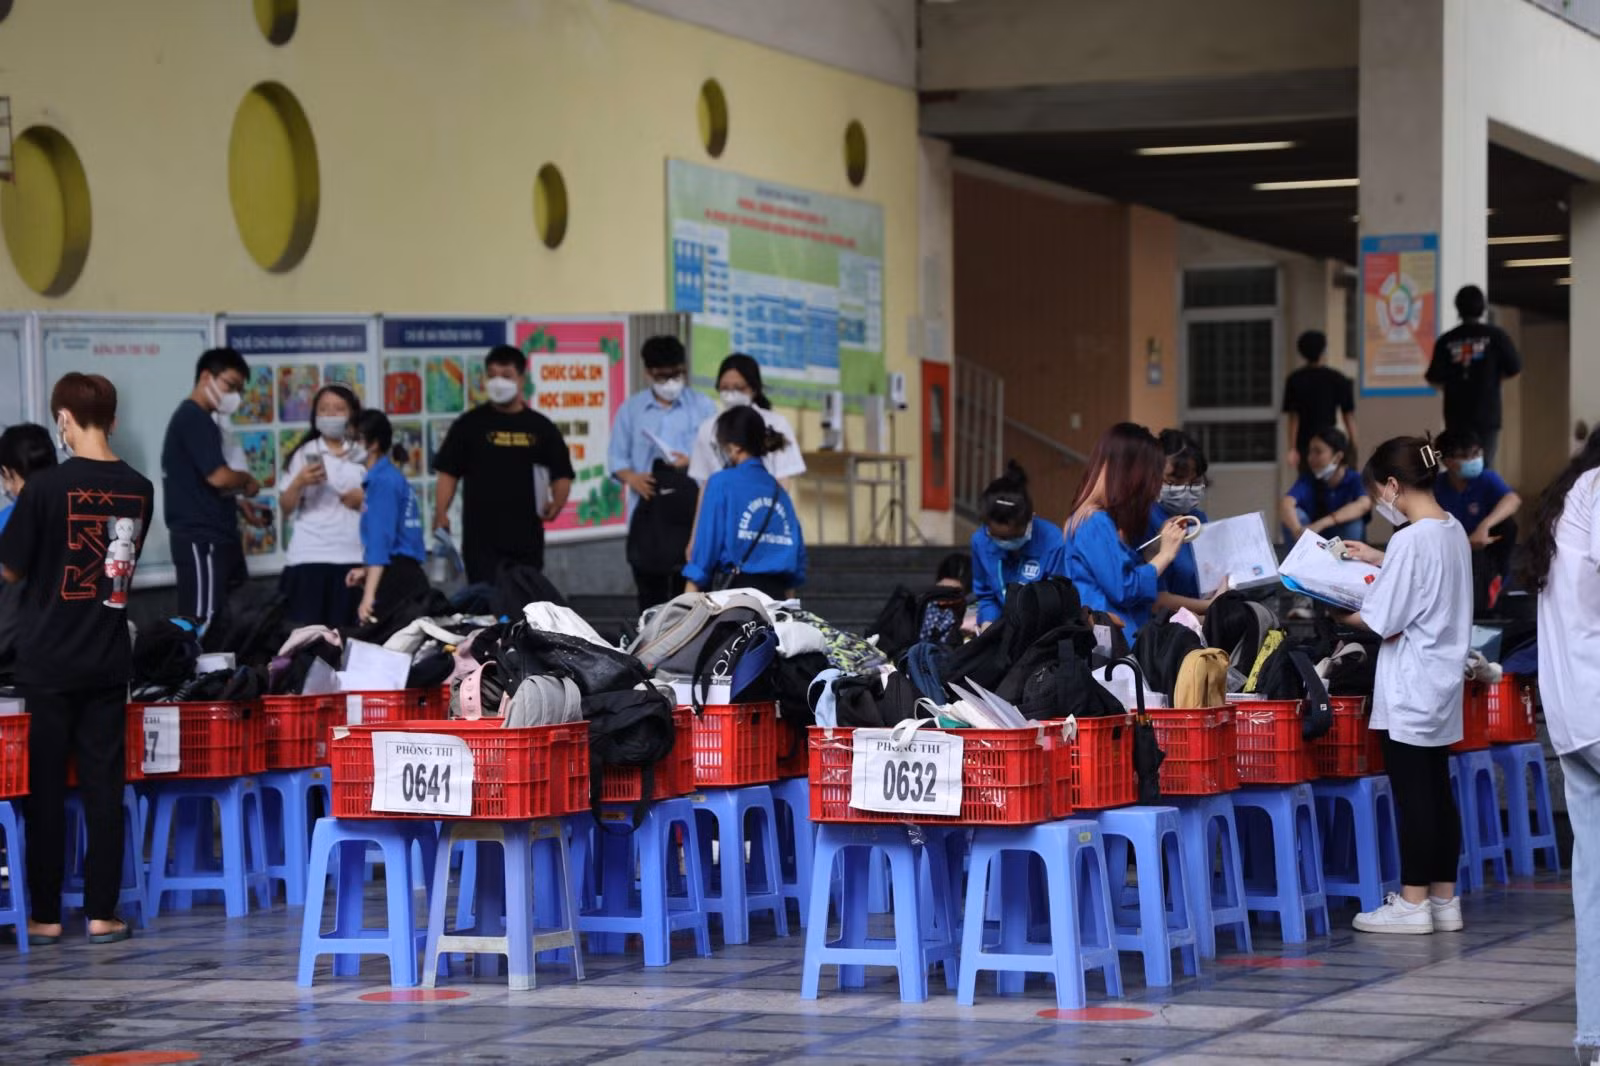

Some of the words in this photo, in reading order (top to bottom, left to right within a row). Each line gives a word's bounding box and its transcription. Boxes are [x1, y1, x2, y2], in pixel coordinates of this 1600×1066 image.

[435, 746, 453, 757] THI
[920, 744, 940, 754] THI
[402, 763, 451, 803] 0641
[883, 760, 937, 802] 0632
